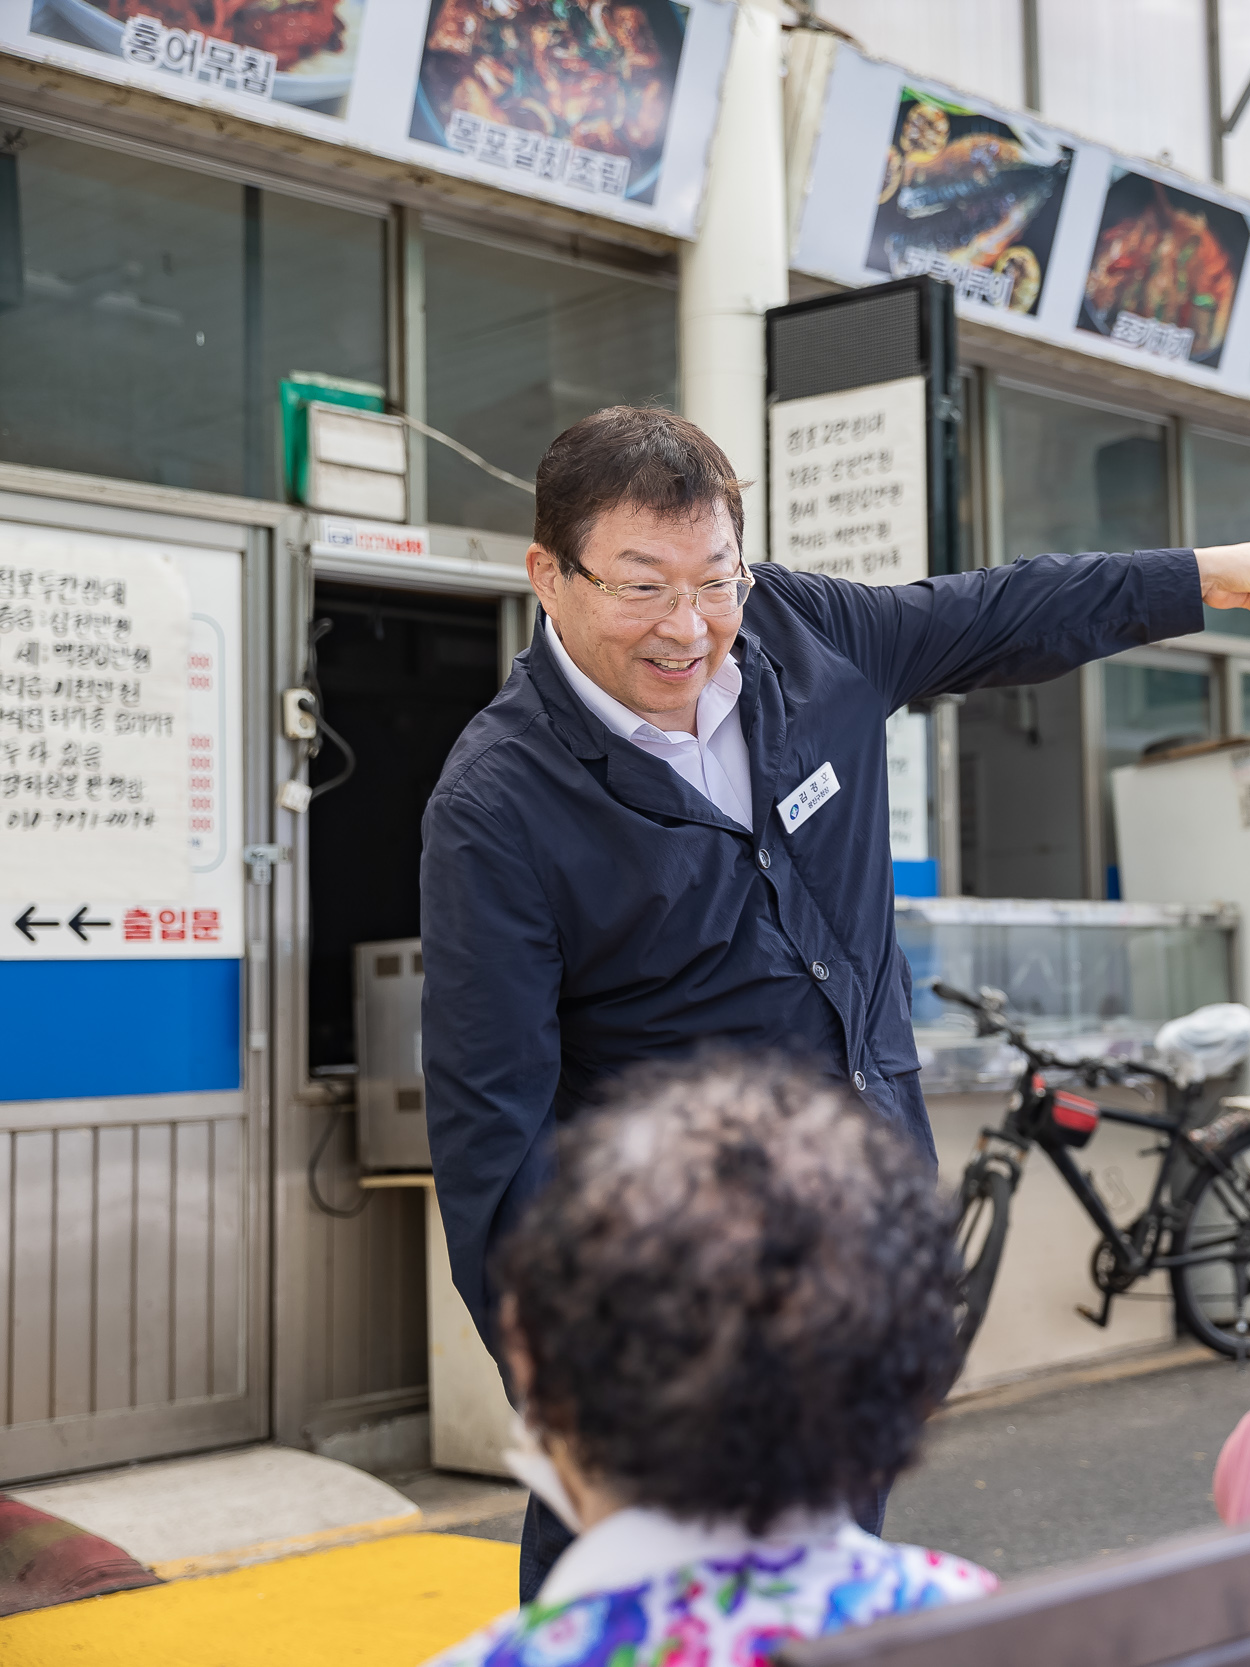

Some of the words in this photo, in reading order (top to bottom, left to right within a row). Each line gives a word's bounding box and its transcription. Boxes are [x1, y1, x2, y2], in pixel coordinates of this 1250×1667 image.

[122, 14, 278, 99] 홍어무침
[446, 109, 632, 196] 목포갈치조림
[807, 786, 830, 809] 광진구청장
[124, 906, 220, 942] 출입문
